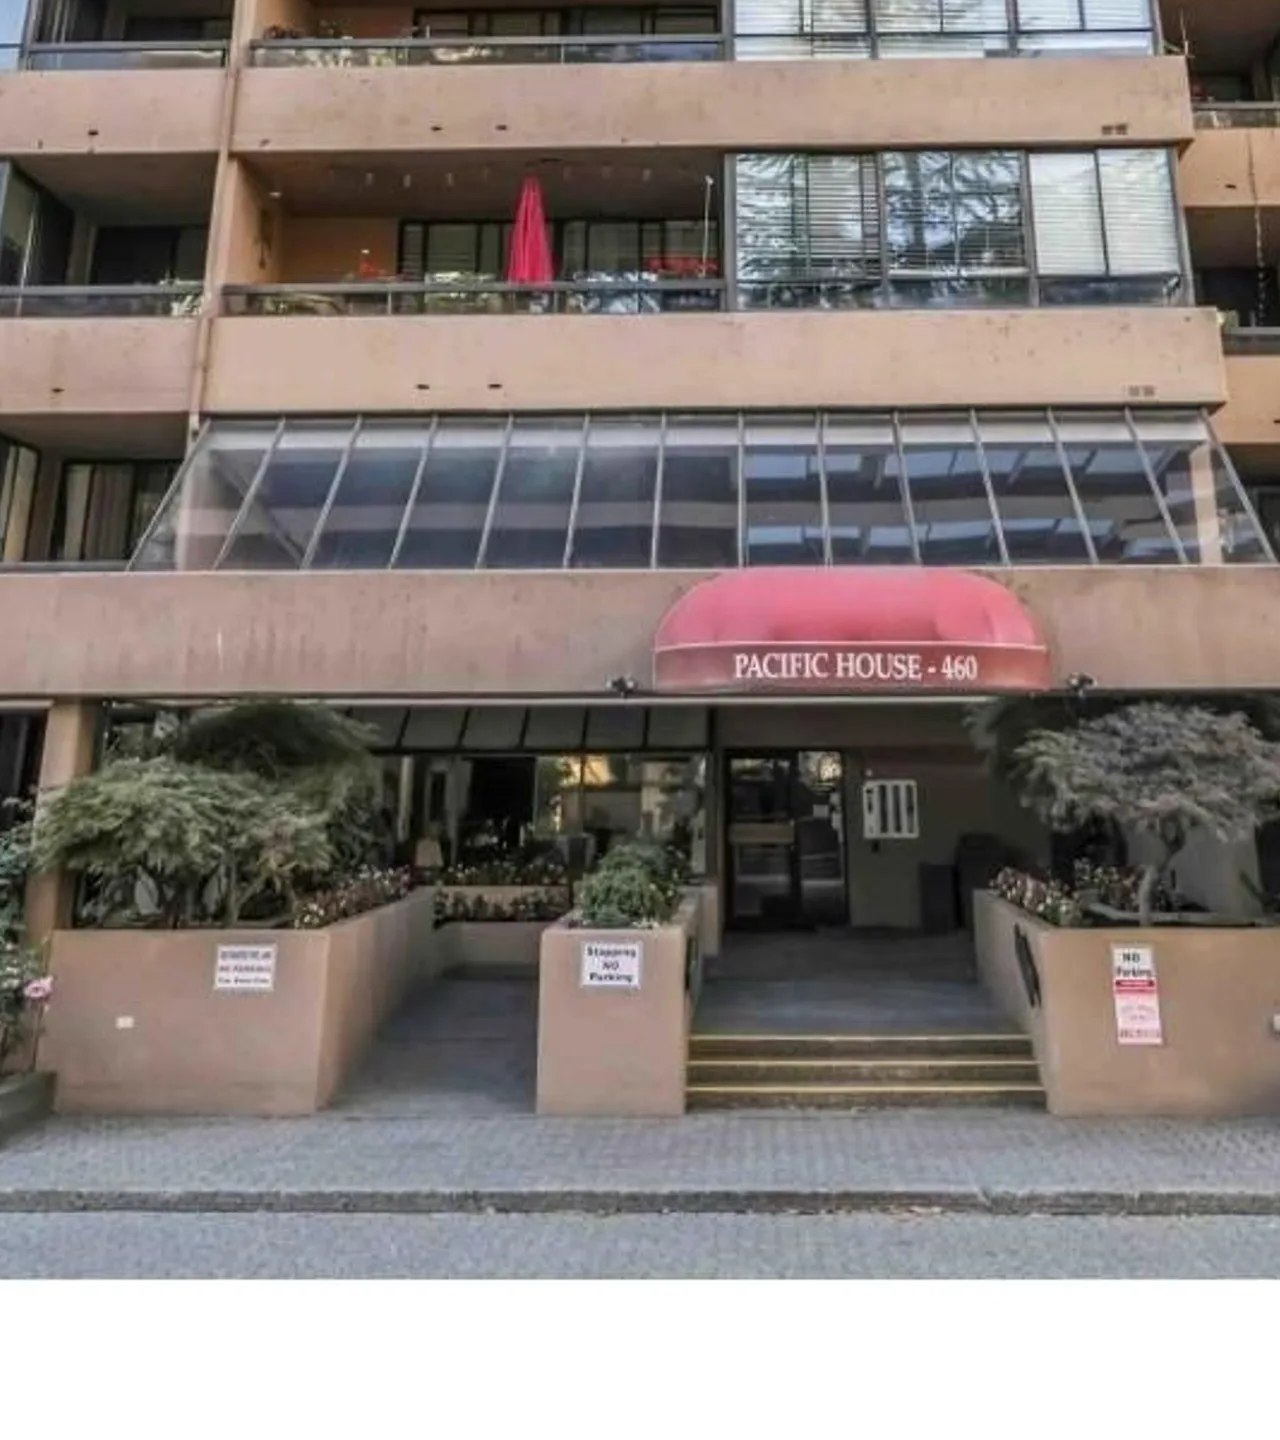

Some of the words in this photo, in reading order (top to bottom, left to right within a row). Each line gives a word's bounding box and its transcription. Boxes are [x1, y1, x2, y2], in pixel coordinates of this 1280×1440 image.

[733, 652, 829, 679] PACIFIC
[836, 652, 922, 681] HOUSE
[940, 655, 978, 681] 460
[602, 960, 620, 971] NO
[589, 972, 633, 983] Parking
